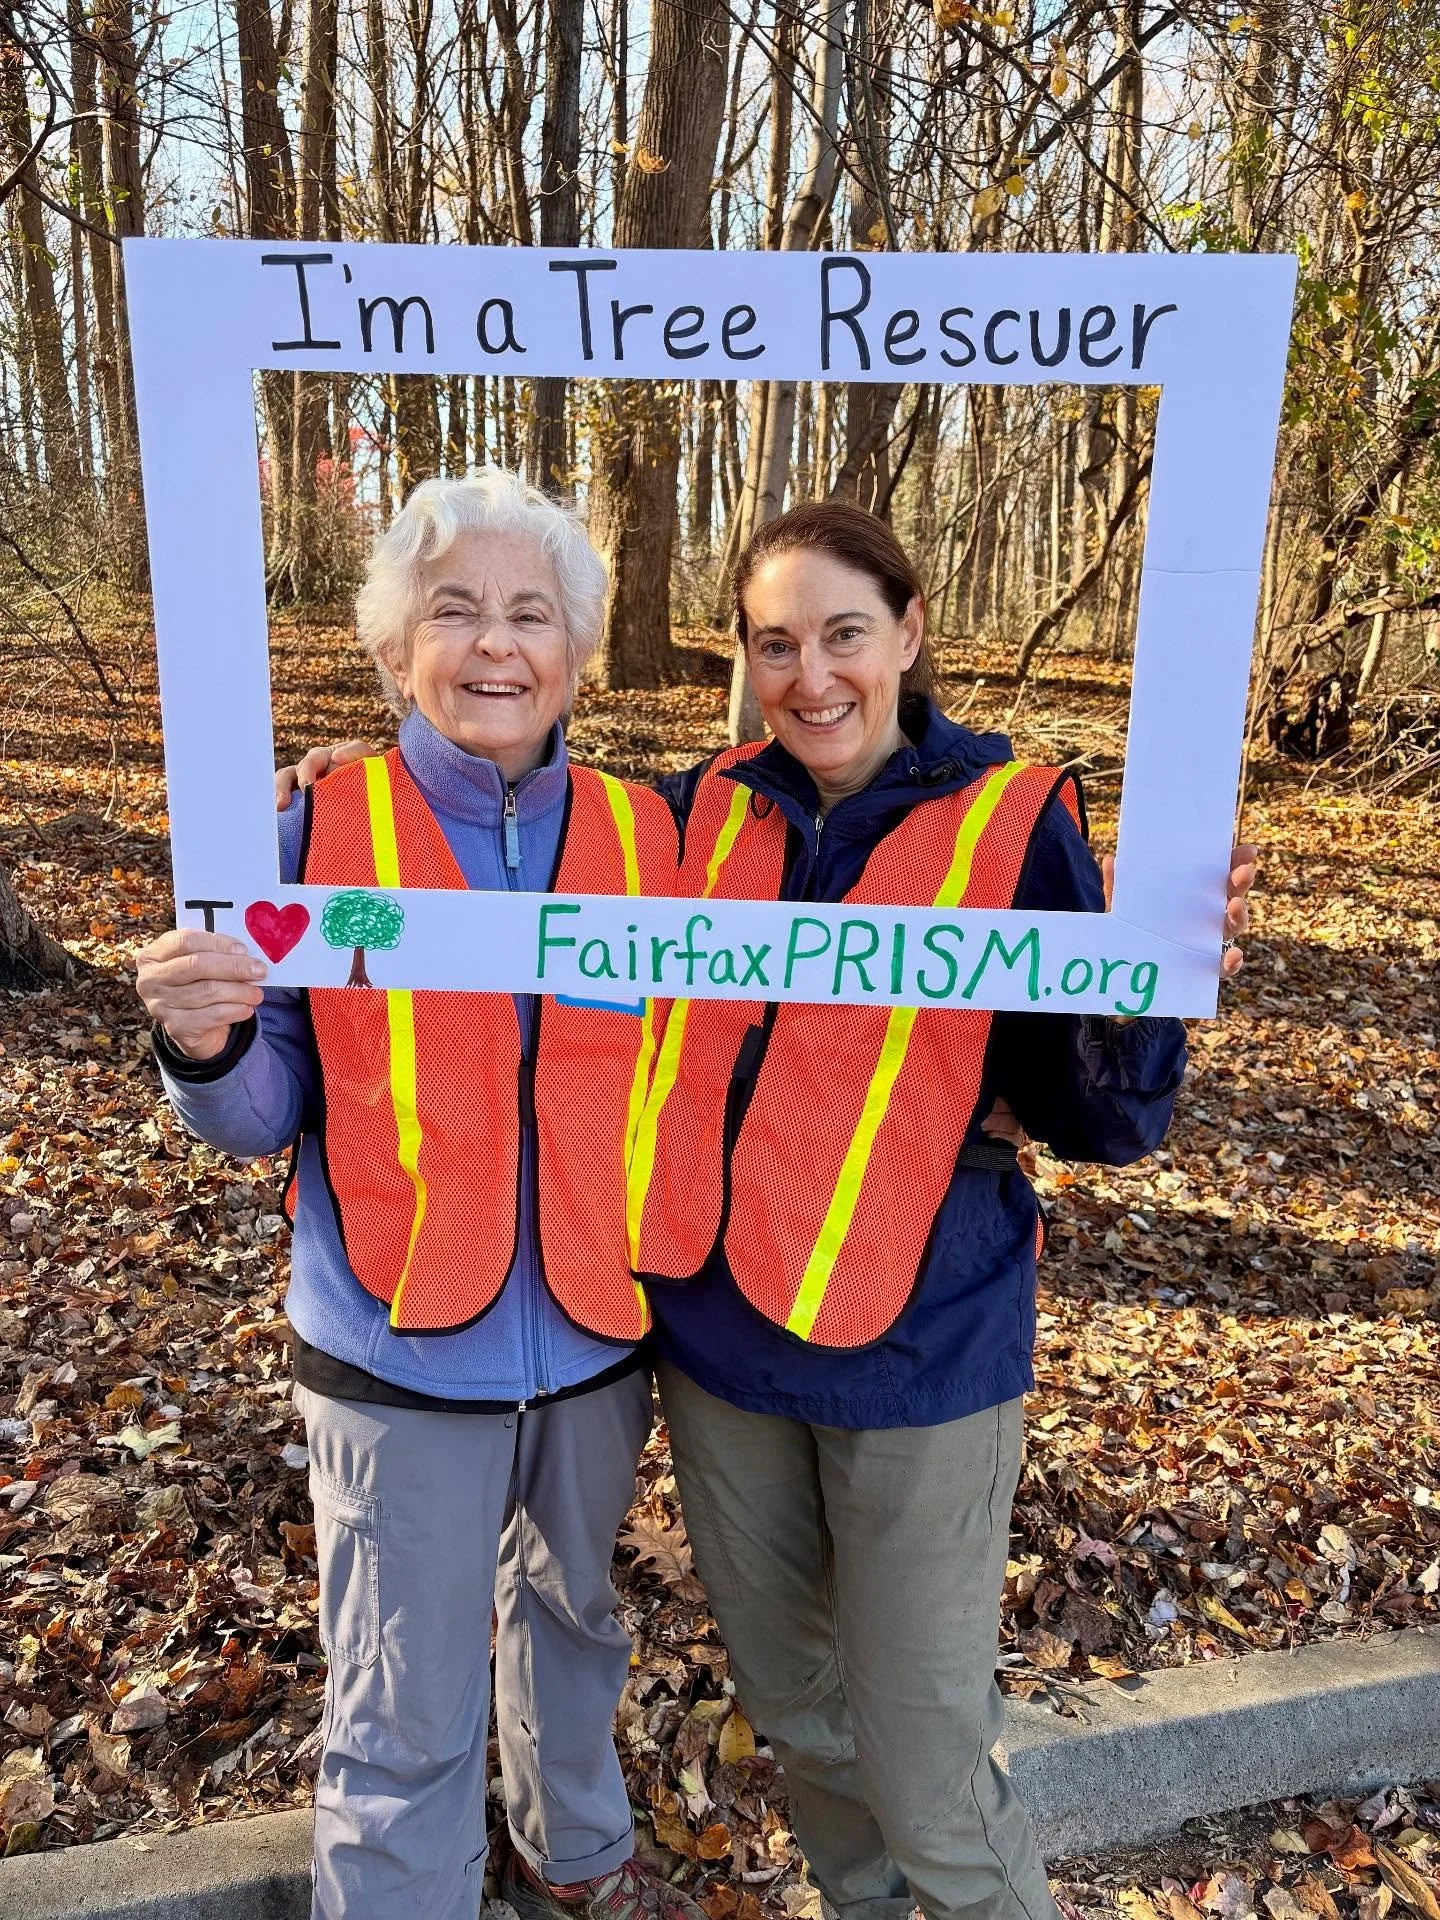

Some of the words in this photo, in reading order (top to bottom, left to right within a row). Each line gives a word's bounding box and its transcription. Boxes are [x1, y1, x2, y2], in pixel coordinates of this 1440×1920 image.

[261, 253, 435, 354] I'm
[476, 298, 527, 355] a
[548, 259, 766, 361] Tree
[820, 256, 1178, 371] Rescuer
[536, 903, 1159, 1016] FairfaxPRISM.org
